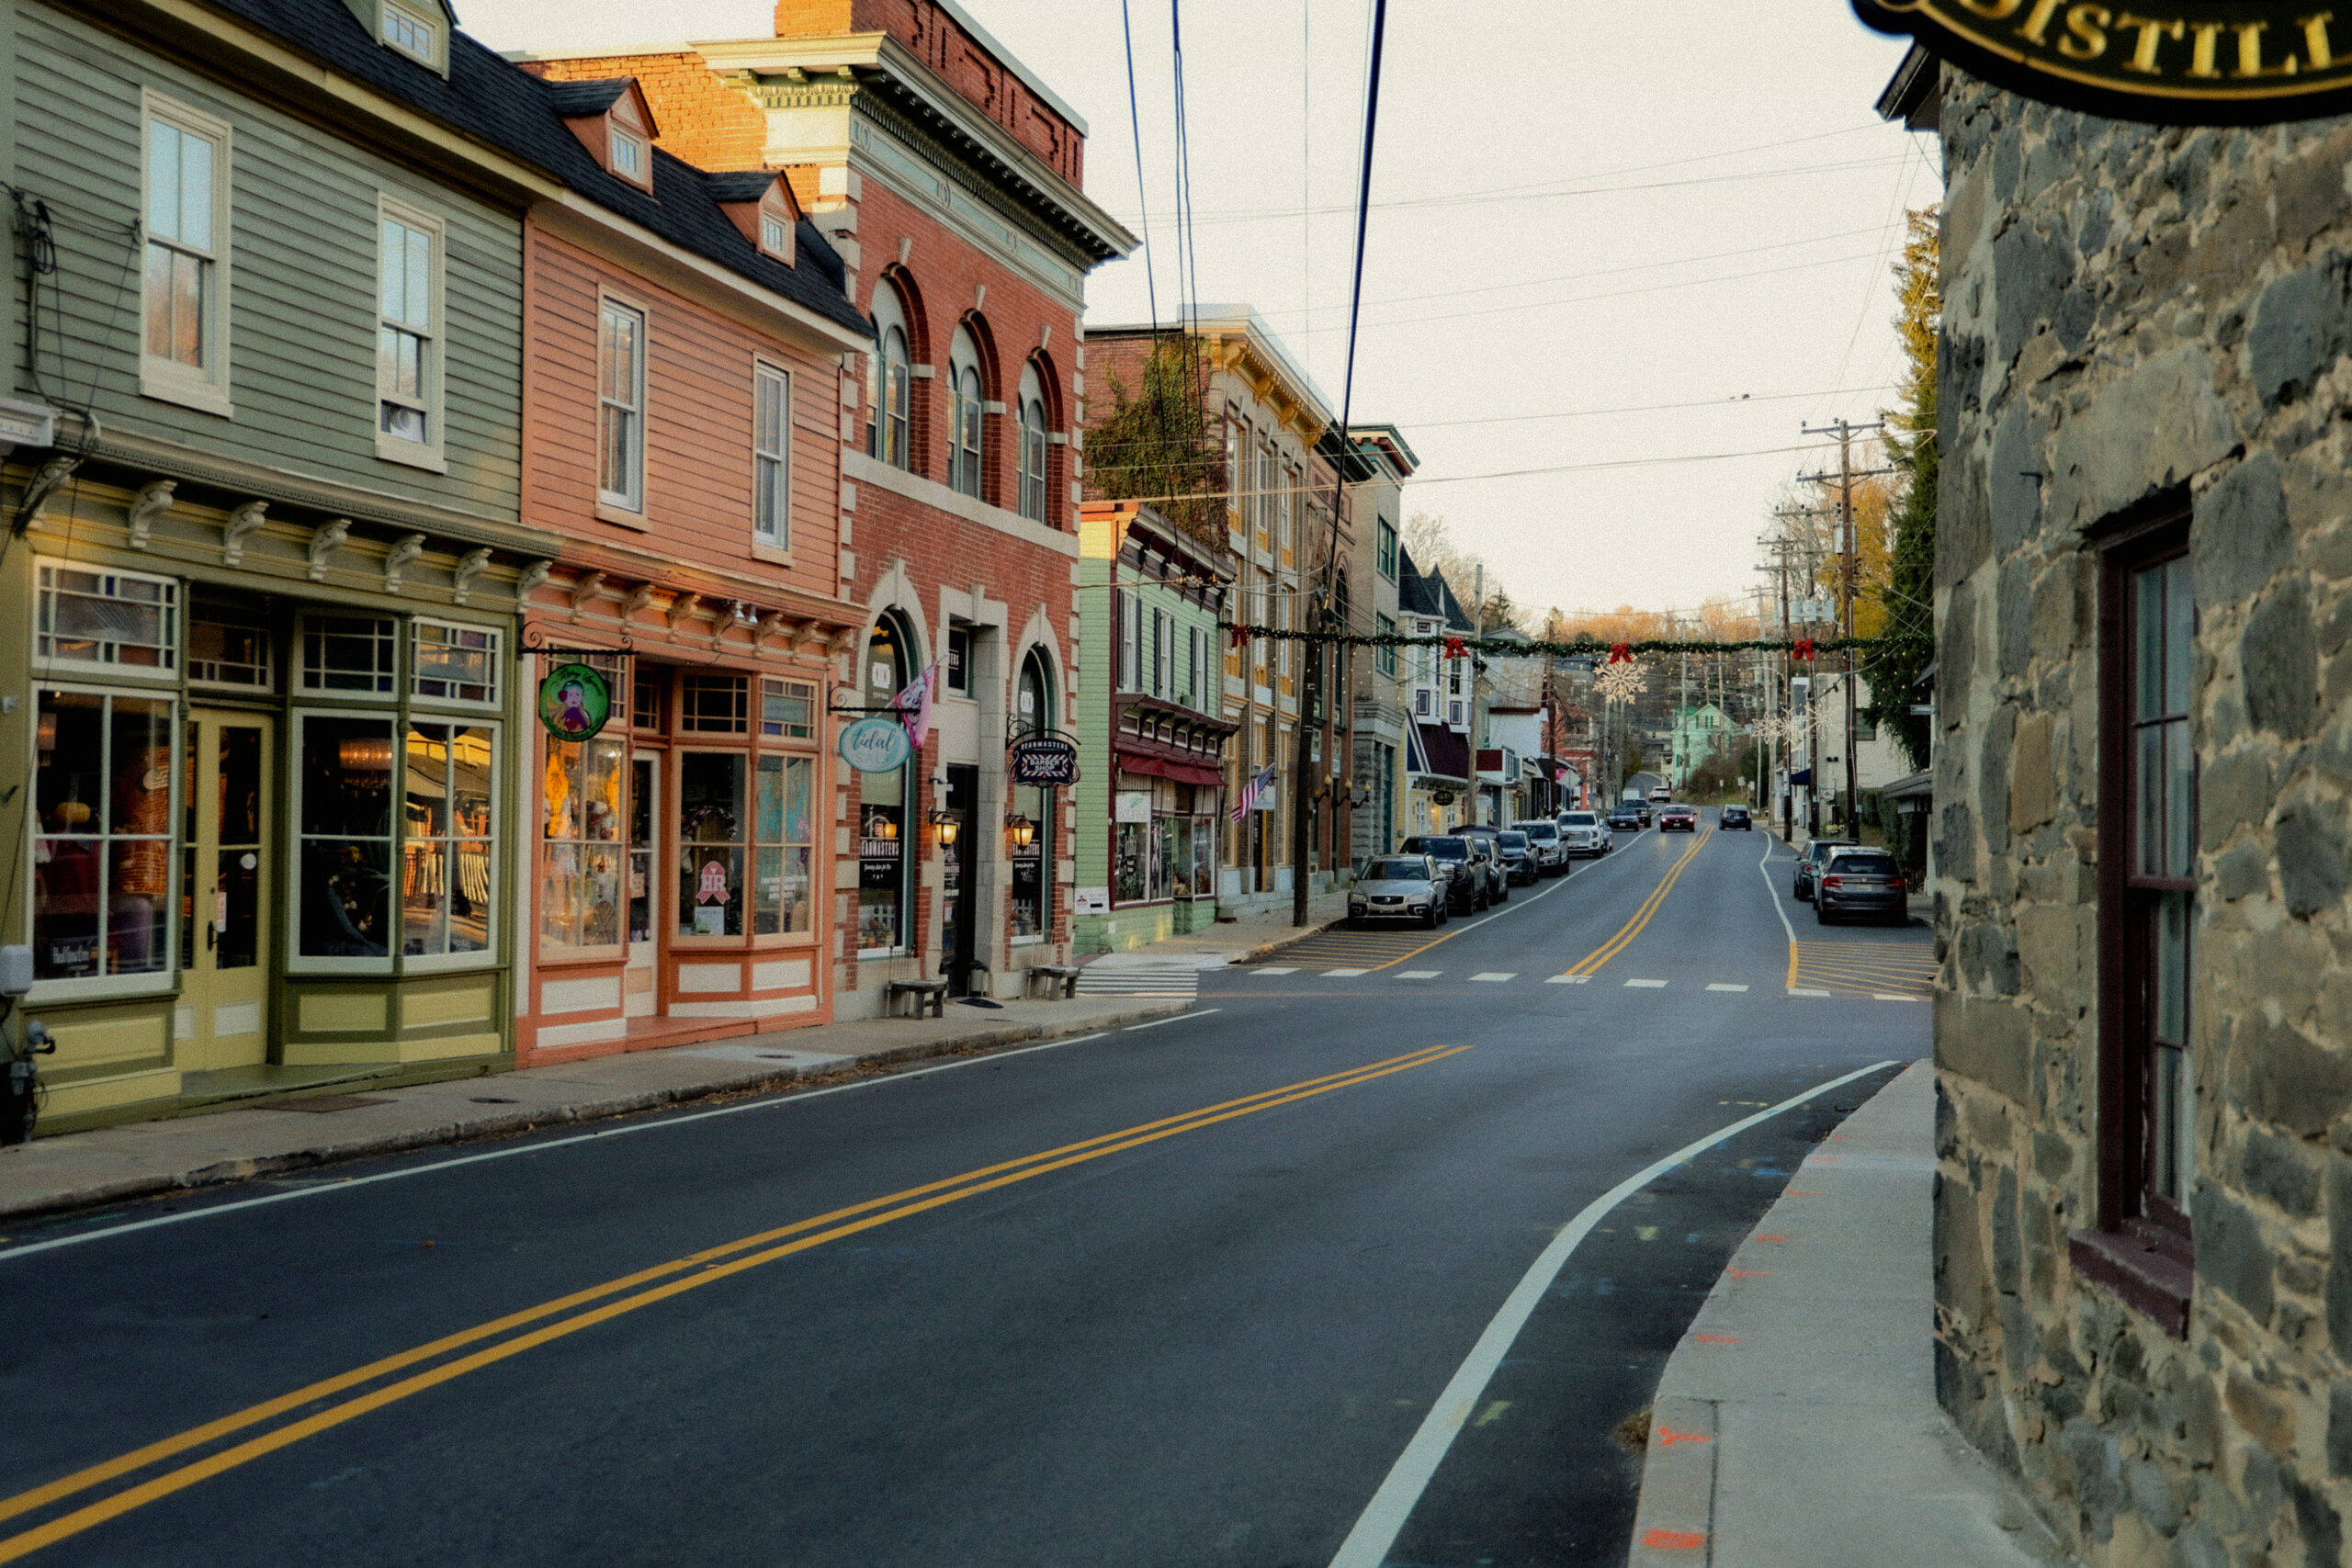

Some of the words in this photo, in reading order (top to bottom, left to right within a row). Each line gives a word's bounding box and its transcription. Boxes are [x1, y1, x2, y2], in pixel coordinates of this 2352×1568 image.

[852, 727, 896, 751] tidal
[861, 840, 899, 858] EADMASTERS
[701, 874, 726, 892] HR
